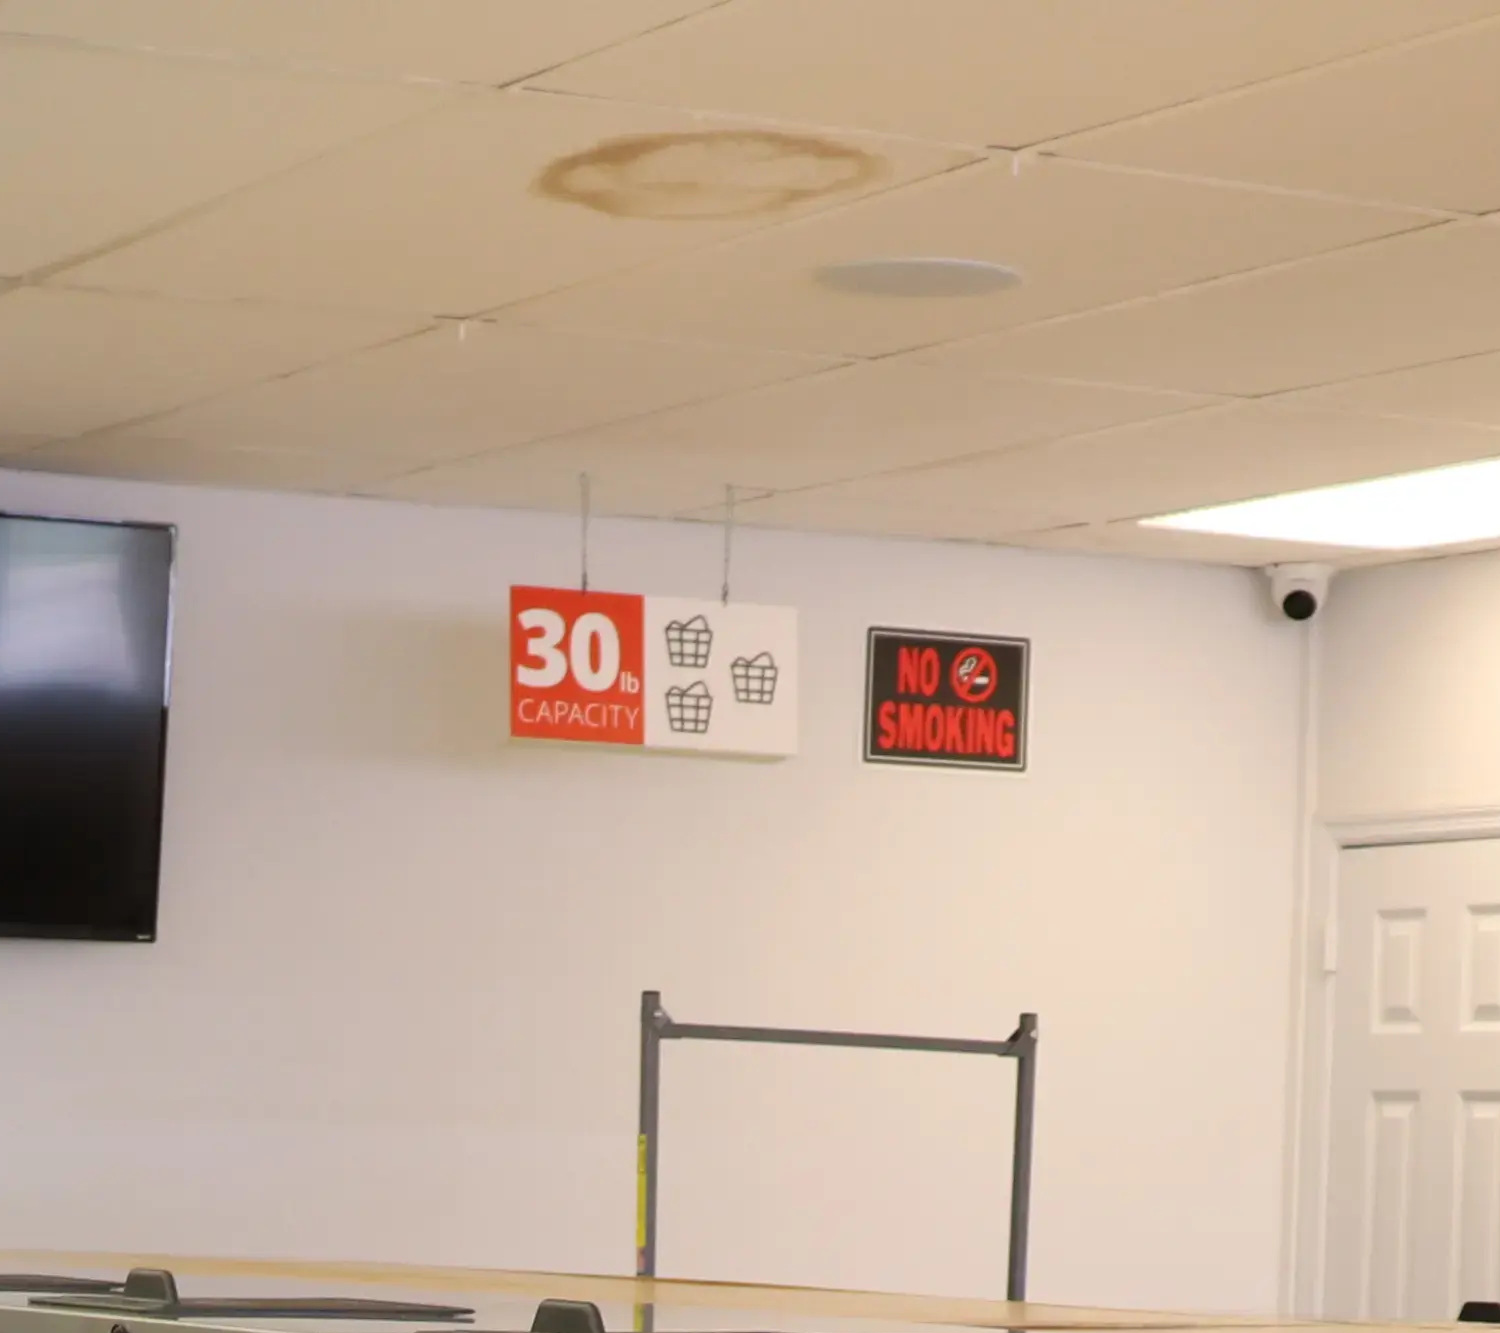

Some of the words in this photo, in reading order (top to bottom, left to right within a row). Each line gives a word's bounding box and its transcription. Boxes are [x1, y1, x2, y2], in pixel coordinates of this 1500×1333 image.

[517, 607, 621, 692] 30
[620, 671, 640, 694] lb
[897, 645, 941, 697] NO
[517, 698, 640, 730] CAPACITY
[878, 700, 1016, 758] SMOKING
